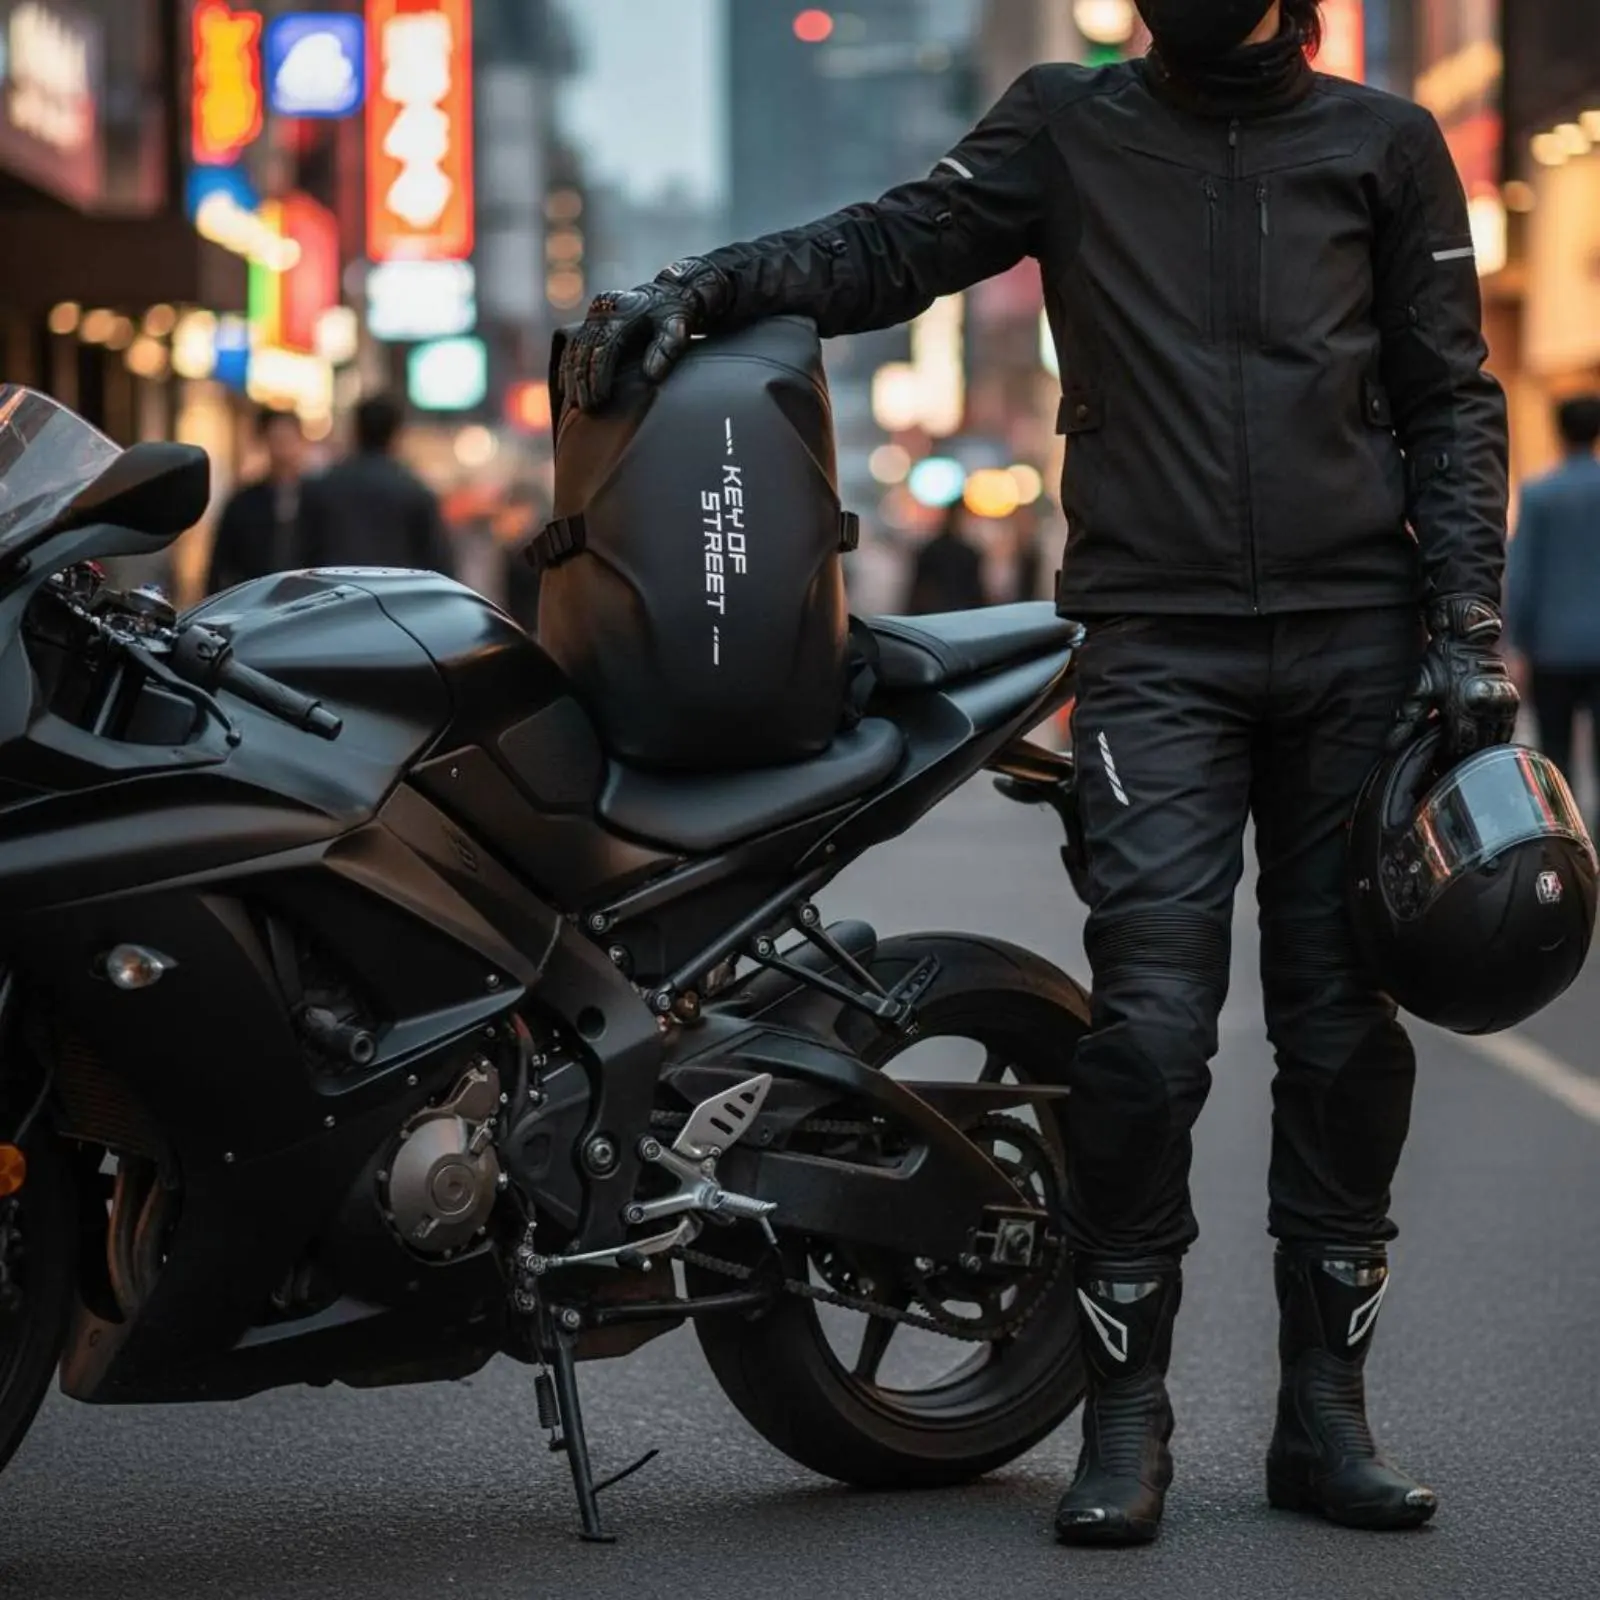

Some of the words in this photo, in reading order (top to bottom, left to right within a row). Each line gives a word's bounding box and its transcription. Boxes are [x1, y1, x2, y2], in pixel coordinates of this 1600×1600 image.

[722, 465, 744, 528] KEY
[701, 490, 725, 615] STREET
[727, 532, 747, 574] OF
